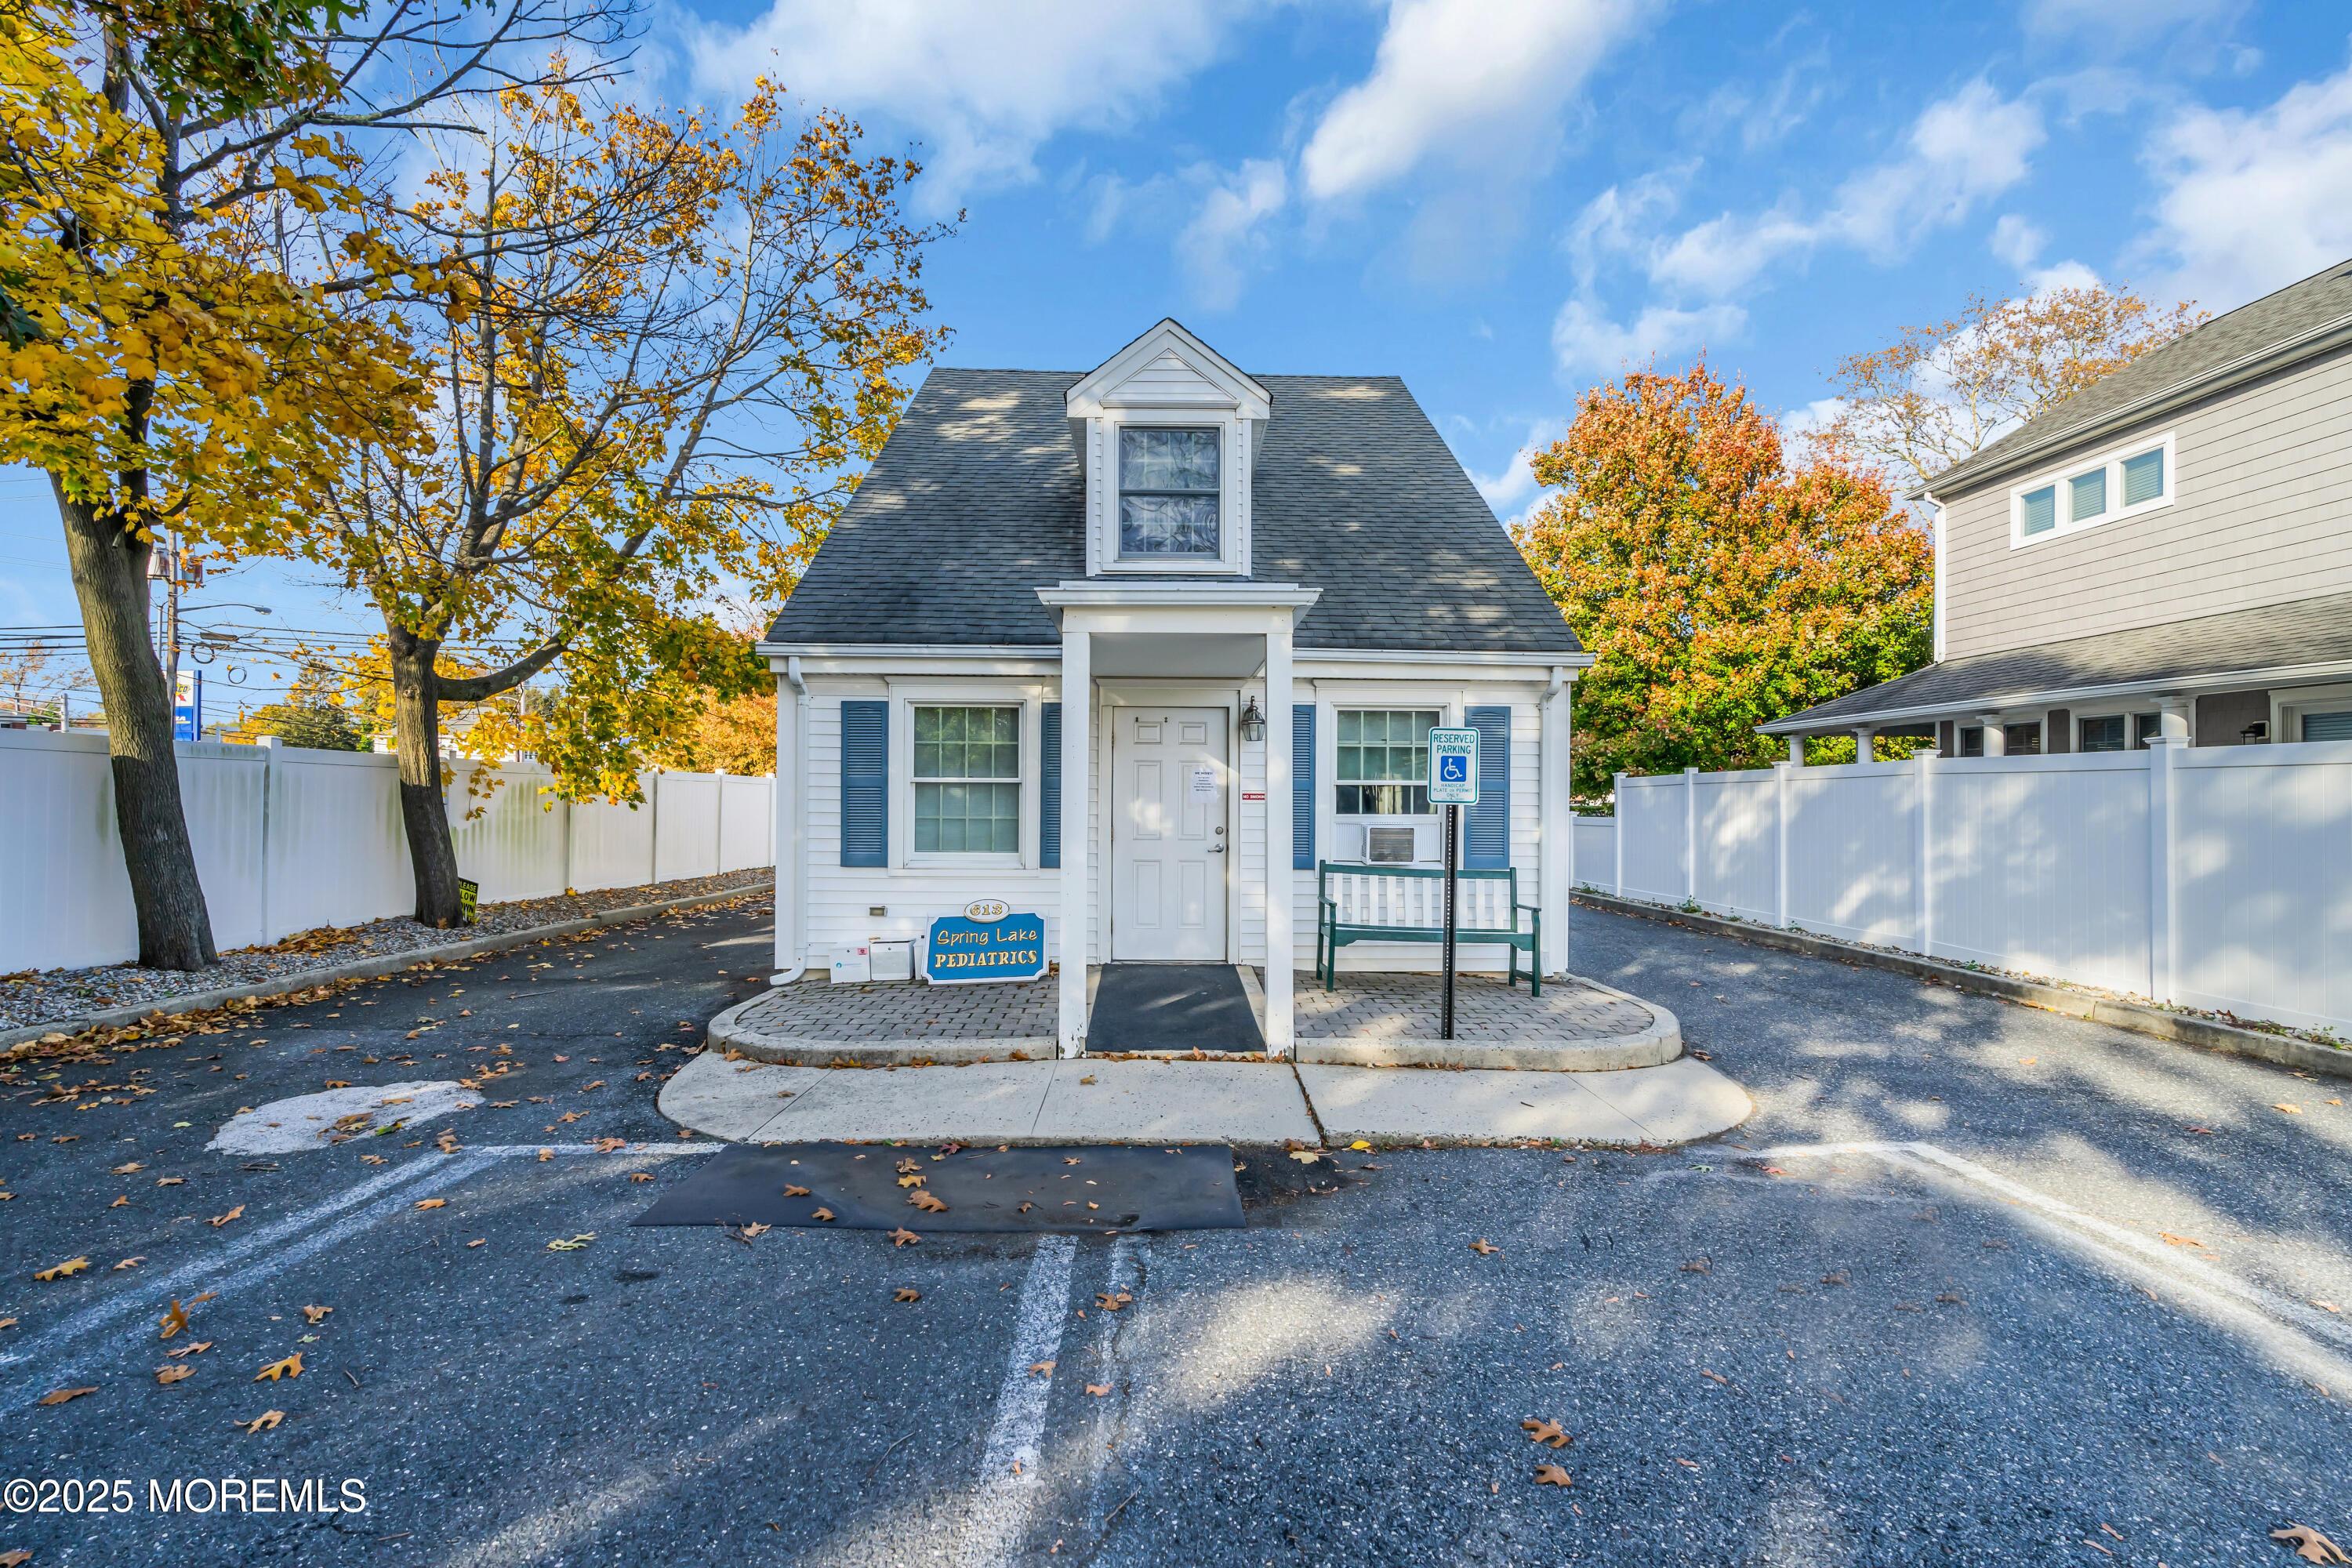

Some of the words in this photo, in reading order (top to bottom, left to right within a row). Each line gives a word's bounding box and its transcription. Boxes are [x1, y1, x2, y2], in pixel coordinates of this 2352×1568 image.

[1433, 734, 1475, 743] RESERVED
[1437, 745, 1471, 754] PARKING
[460, 890, 476, 902] LOW
[970, 904, 1003, 916] 613
[937, 930, 989, 946] Spring
[996, 927, 1037, 942] Lake
[935, 950, 1037, 967] PEDIATRICS
